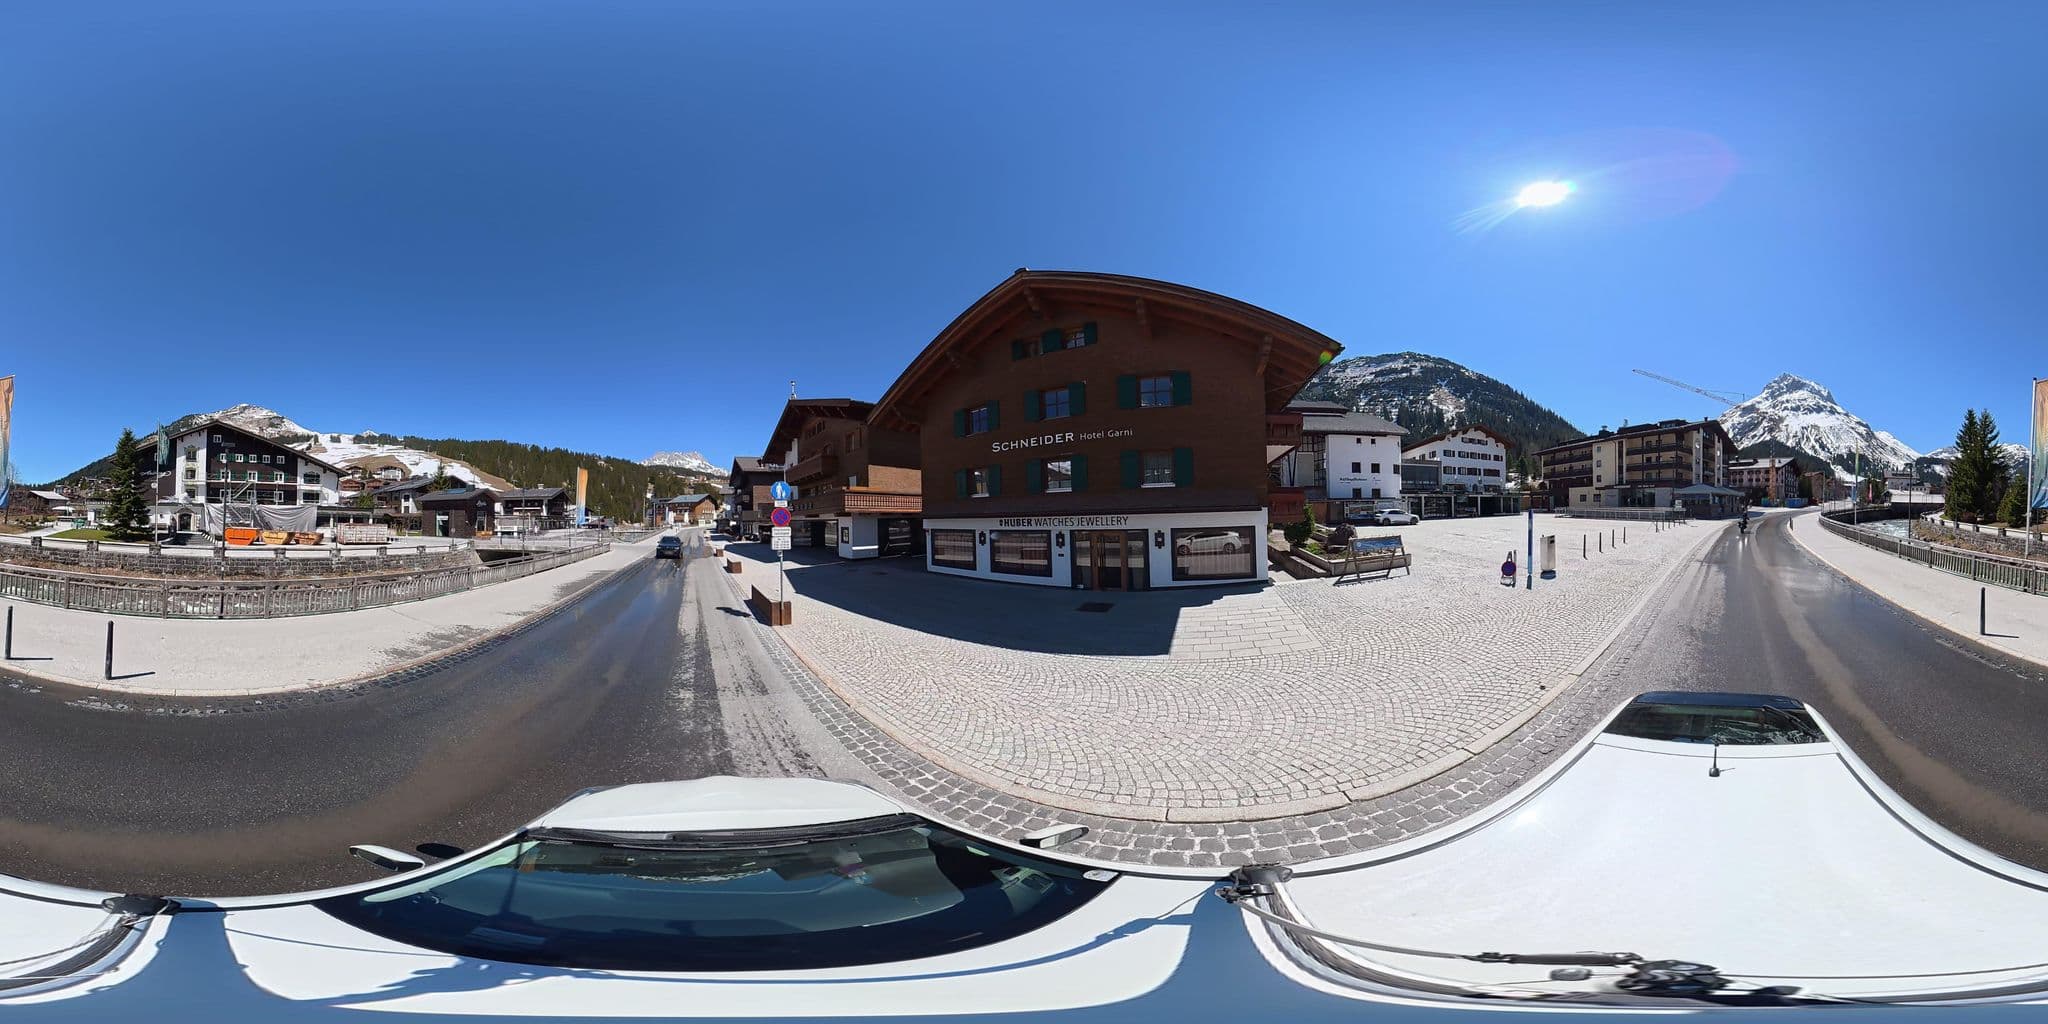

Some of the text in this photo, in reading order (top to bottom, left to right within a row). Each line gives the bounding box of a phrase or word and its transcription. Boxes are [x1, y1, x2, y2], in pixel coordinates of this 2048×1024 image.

[992, 429, 1133, 452] SCHNEIDER Hotel Garni
[1004, 516, 1129, 527] HUBER WATCHES JEWELLERY
